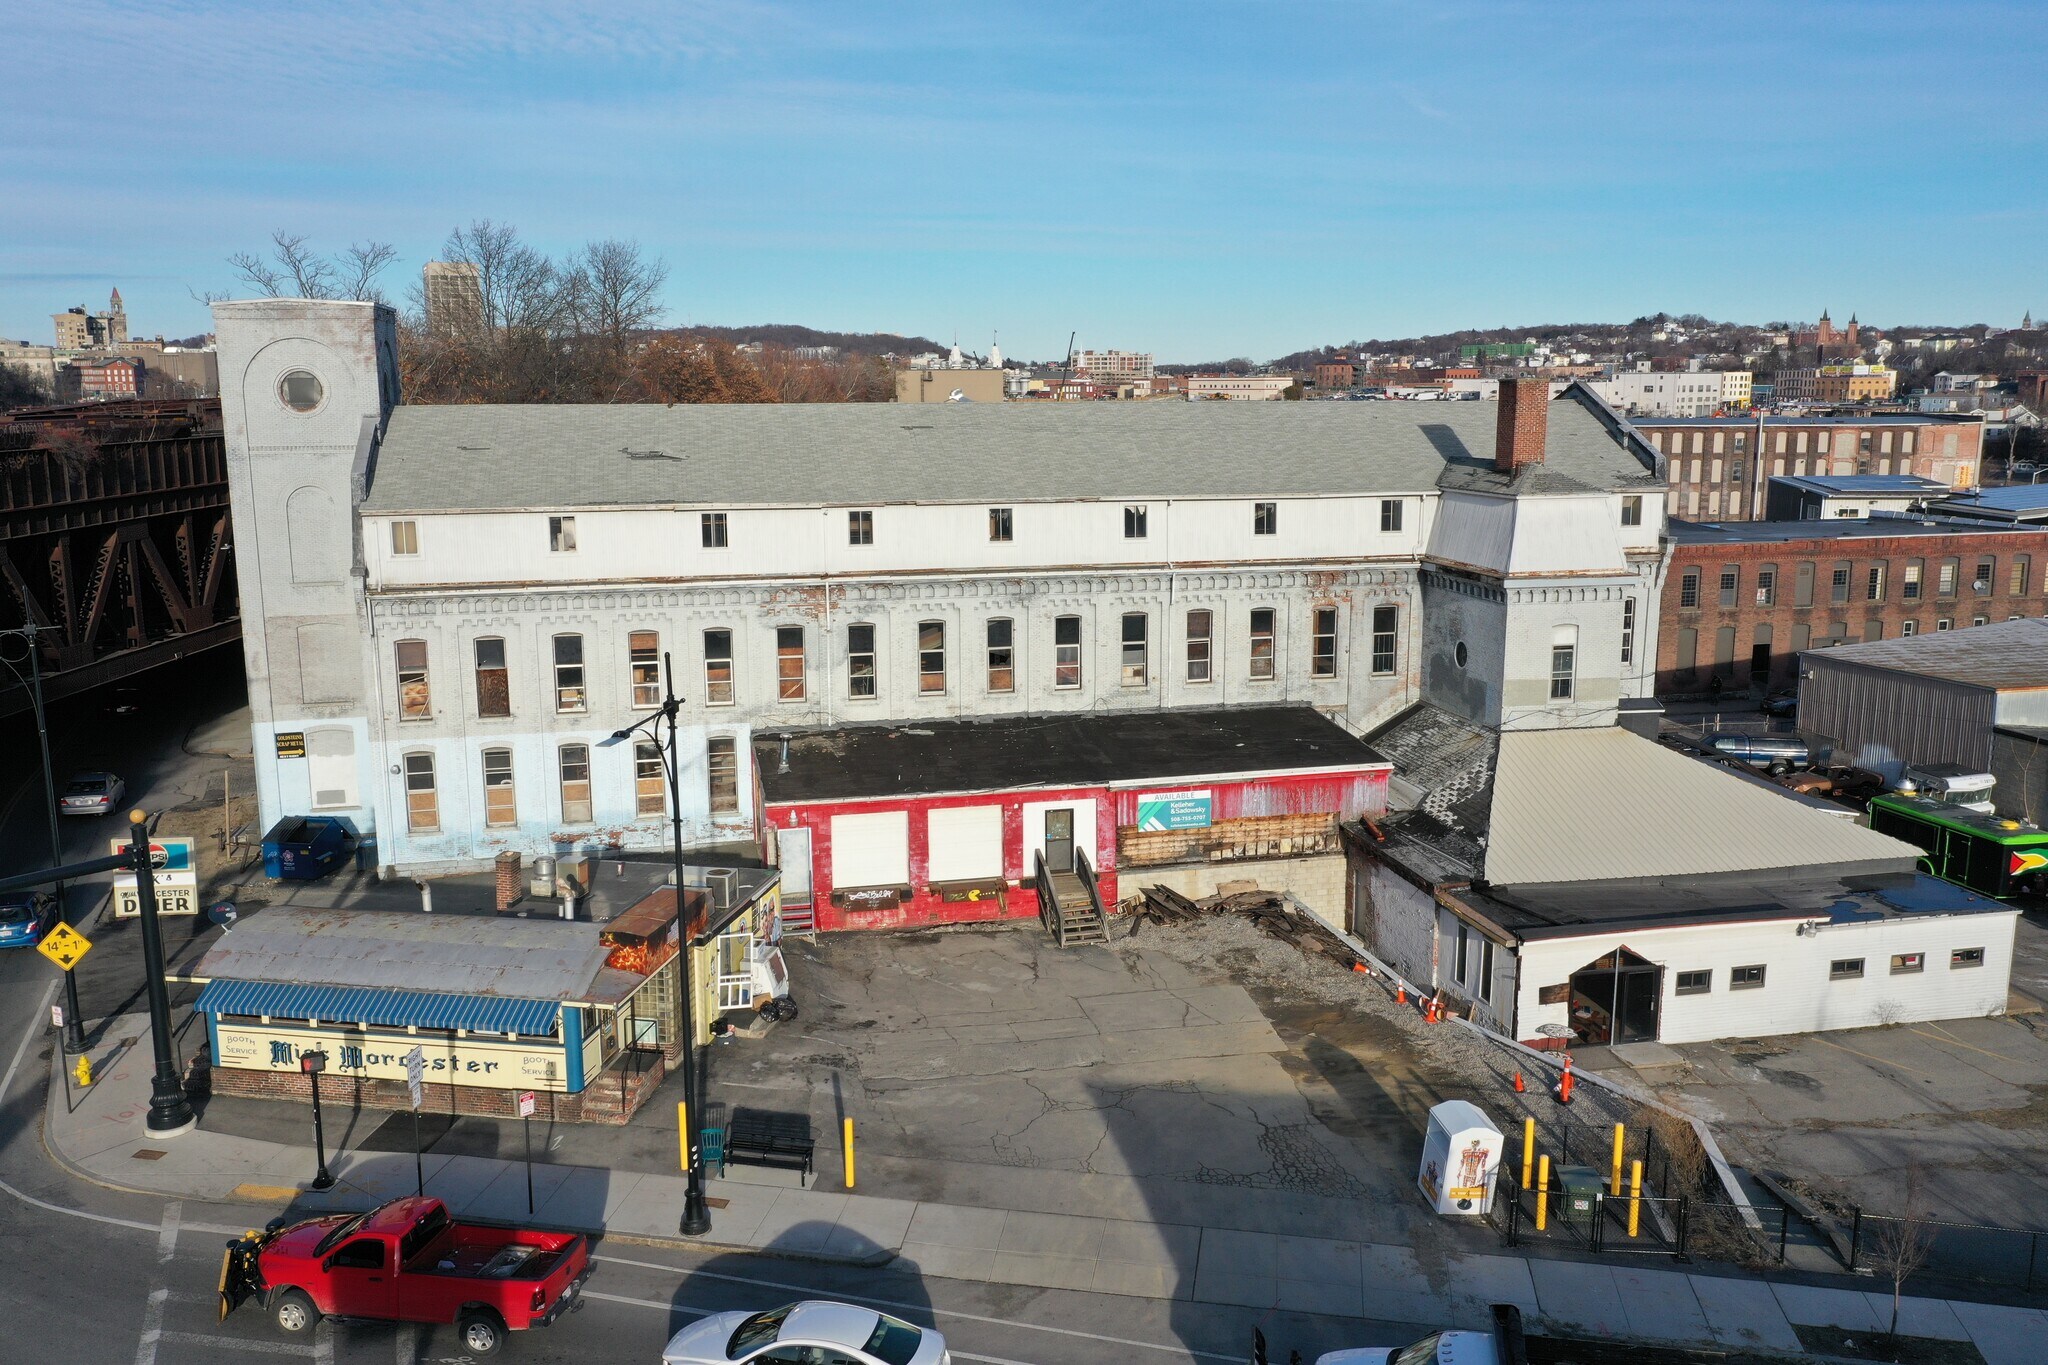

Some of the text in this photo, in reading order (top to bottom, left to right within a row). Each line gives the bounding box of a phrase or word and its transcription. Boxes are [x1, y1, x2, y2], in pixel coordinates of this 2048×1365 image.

[1154, 792, 1195, 801] AVAILABLE
[1176, 806, 1206, 814] Sadowsky
[155, 889, 190, 897] CESTER
[124, 897, 189, 913] DER
[226, 1035, 256, 1046] BOOTH
[225, 1044, 258, 1056] SERVICE
[268, 1039, 330, 1069] Mi
[408, 1050, 421, 1064] RIGHT
[523, 1056, 554, 1068] BOOTH
[409, 1060, 421, 1074] TURN
[521, 1066, 556, 1077] SERVICE
[410, 1070, 421, 1084] ONLY
